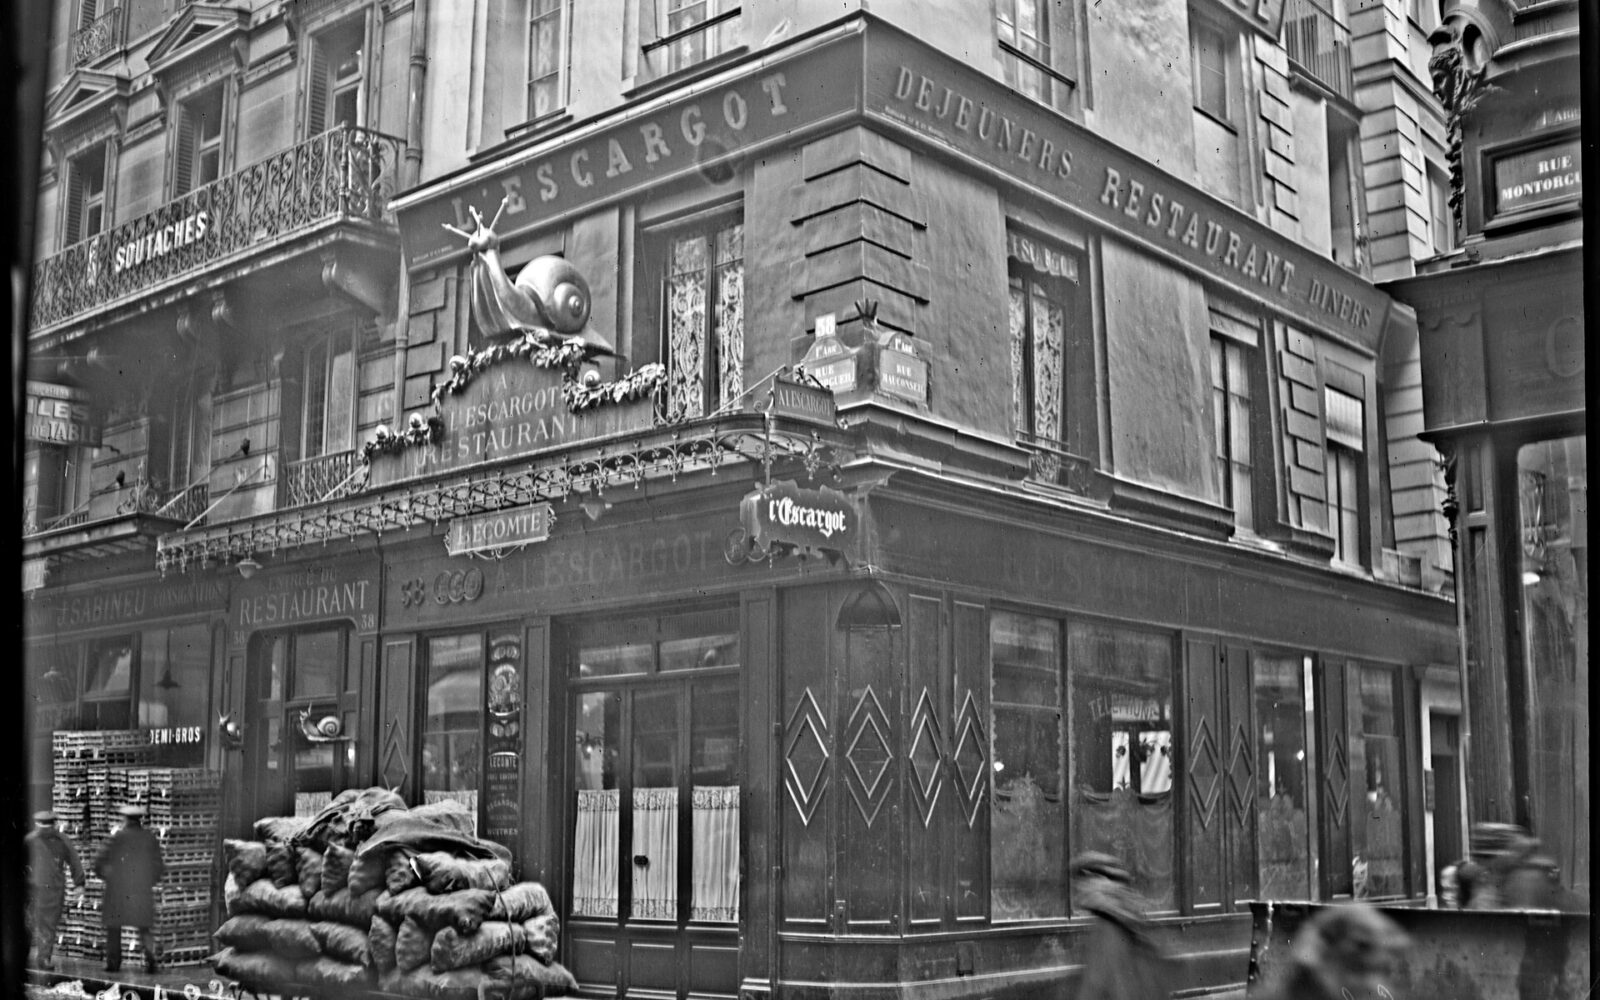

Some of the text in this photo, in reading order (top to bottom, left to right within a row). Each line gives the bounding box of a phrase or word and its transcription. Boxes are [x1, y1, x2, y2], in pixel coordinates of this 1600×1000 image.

[451, 72, 788, 232] L'ESCARGOT
[1538, 155, 1572, 175] RUE
[895, 66, 1372, 329] DEJEUNERS RESTAURANT DINERS
[115, 211, 208, 273] SOUTACHES
[815, 363, 835, 379] RUE
[896, 363, 912, 378] RUE
[450, 385, 560, 432] L'ESCARGOT
[421, 411, 579, 466] RESTAURANT
[768, 495, 847, 540] l'Escargot
[239, 579, 370, 626] RESTAURANT
